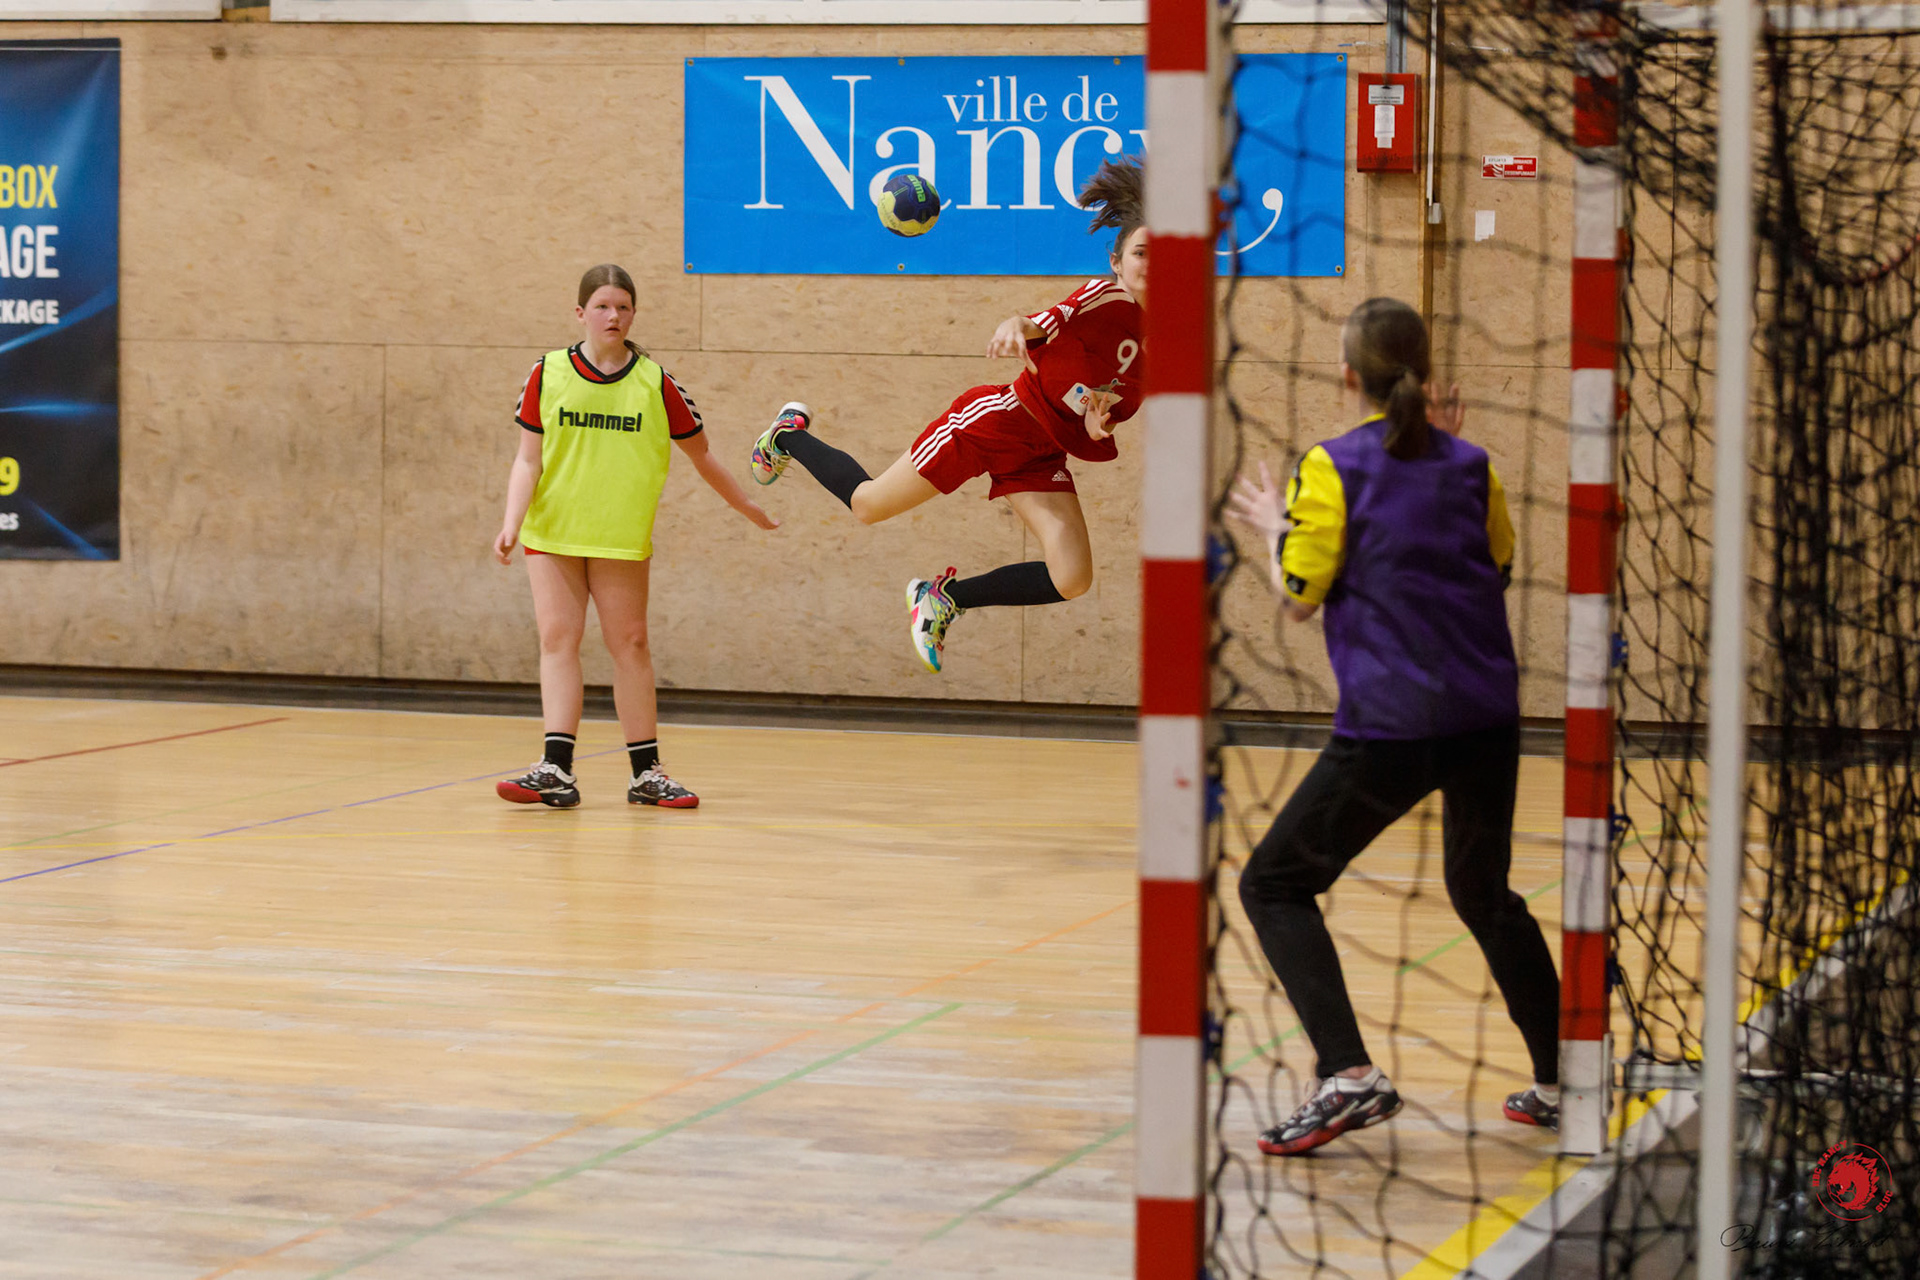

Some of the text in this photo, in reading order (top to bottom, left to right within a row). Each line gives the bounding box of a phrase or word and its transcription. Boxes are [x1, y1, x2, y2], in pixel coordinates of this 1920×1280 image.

[943, 75, 1119, 122] ville de
[0, 164, 58, 209] BOX
[1117, 336, 1146, 374] 9
[559, 406, 642, 432] hummel
